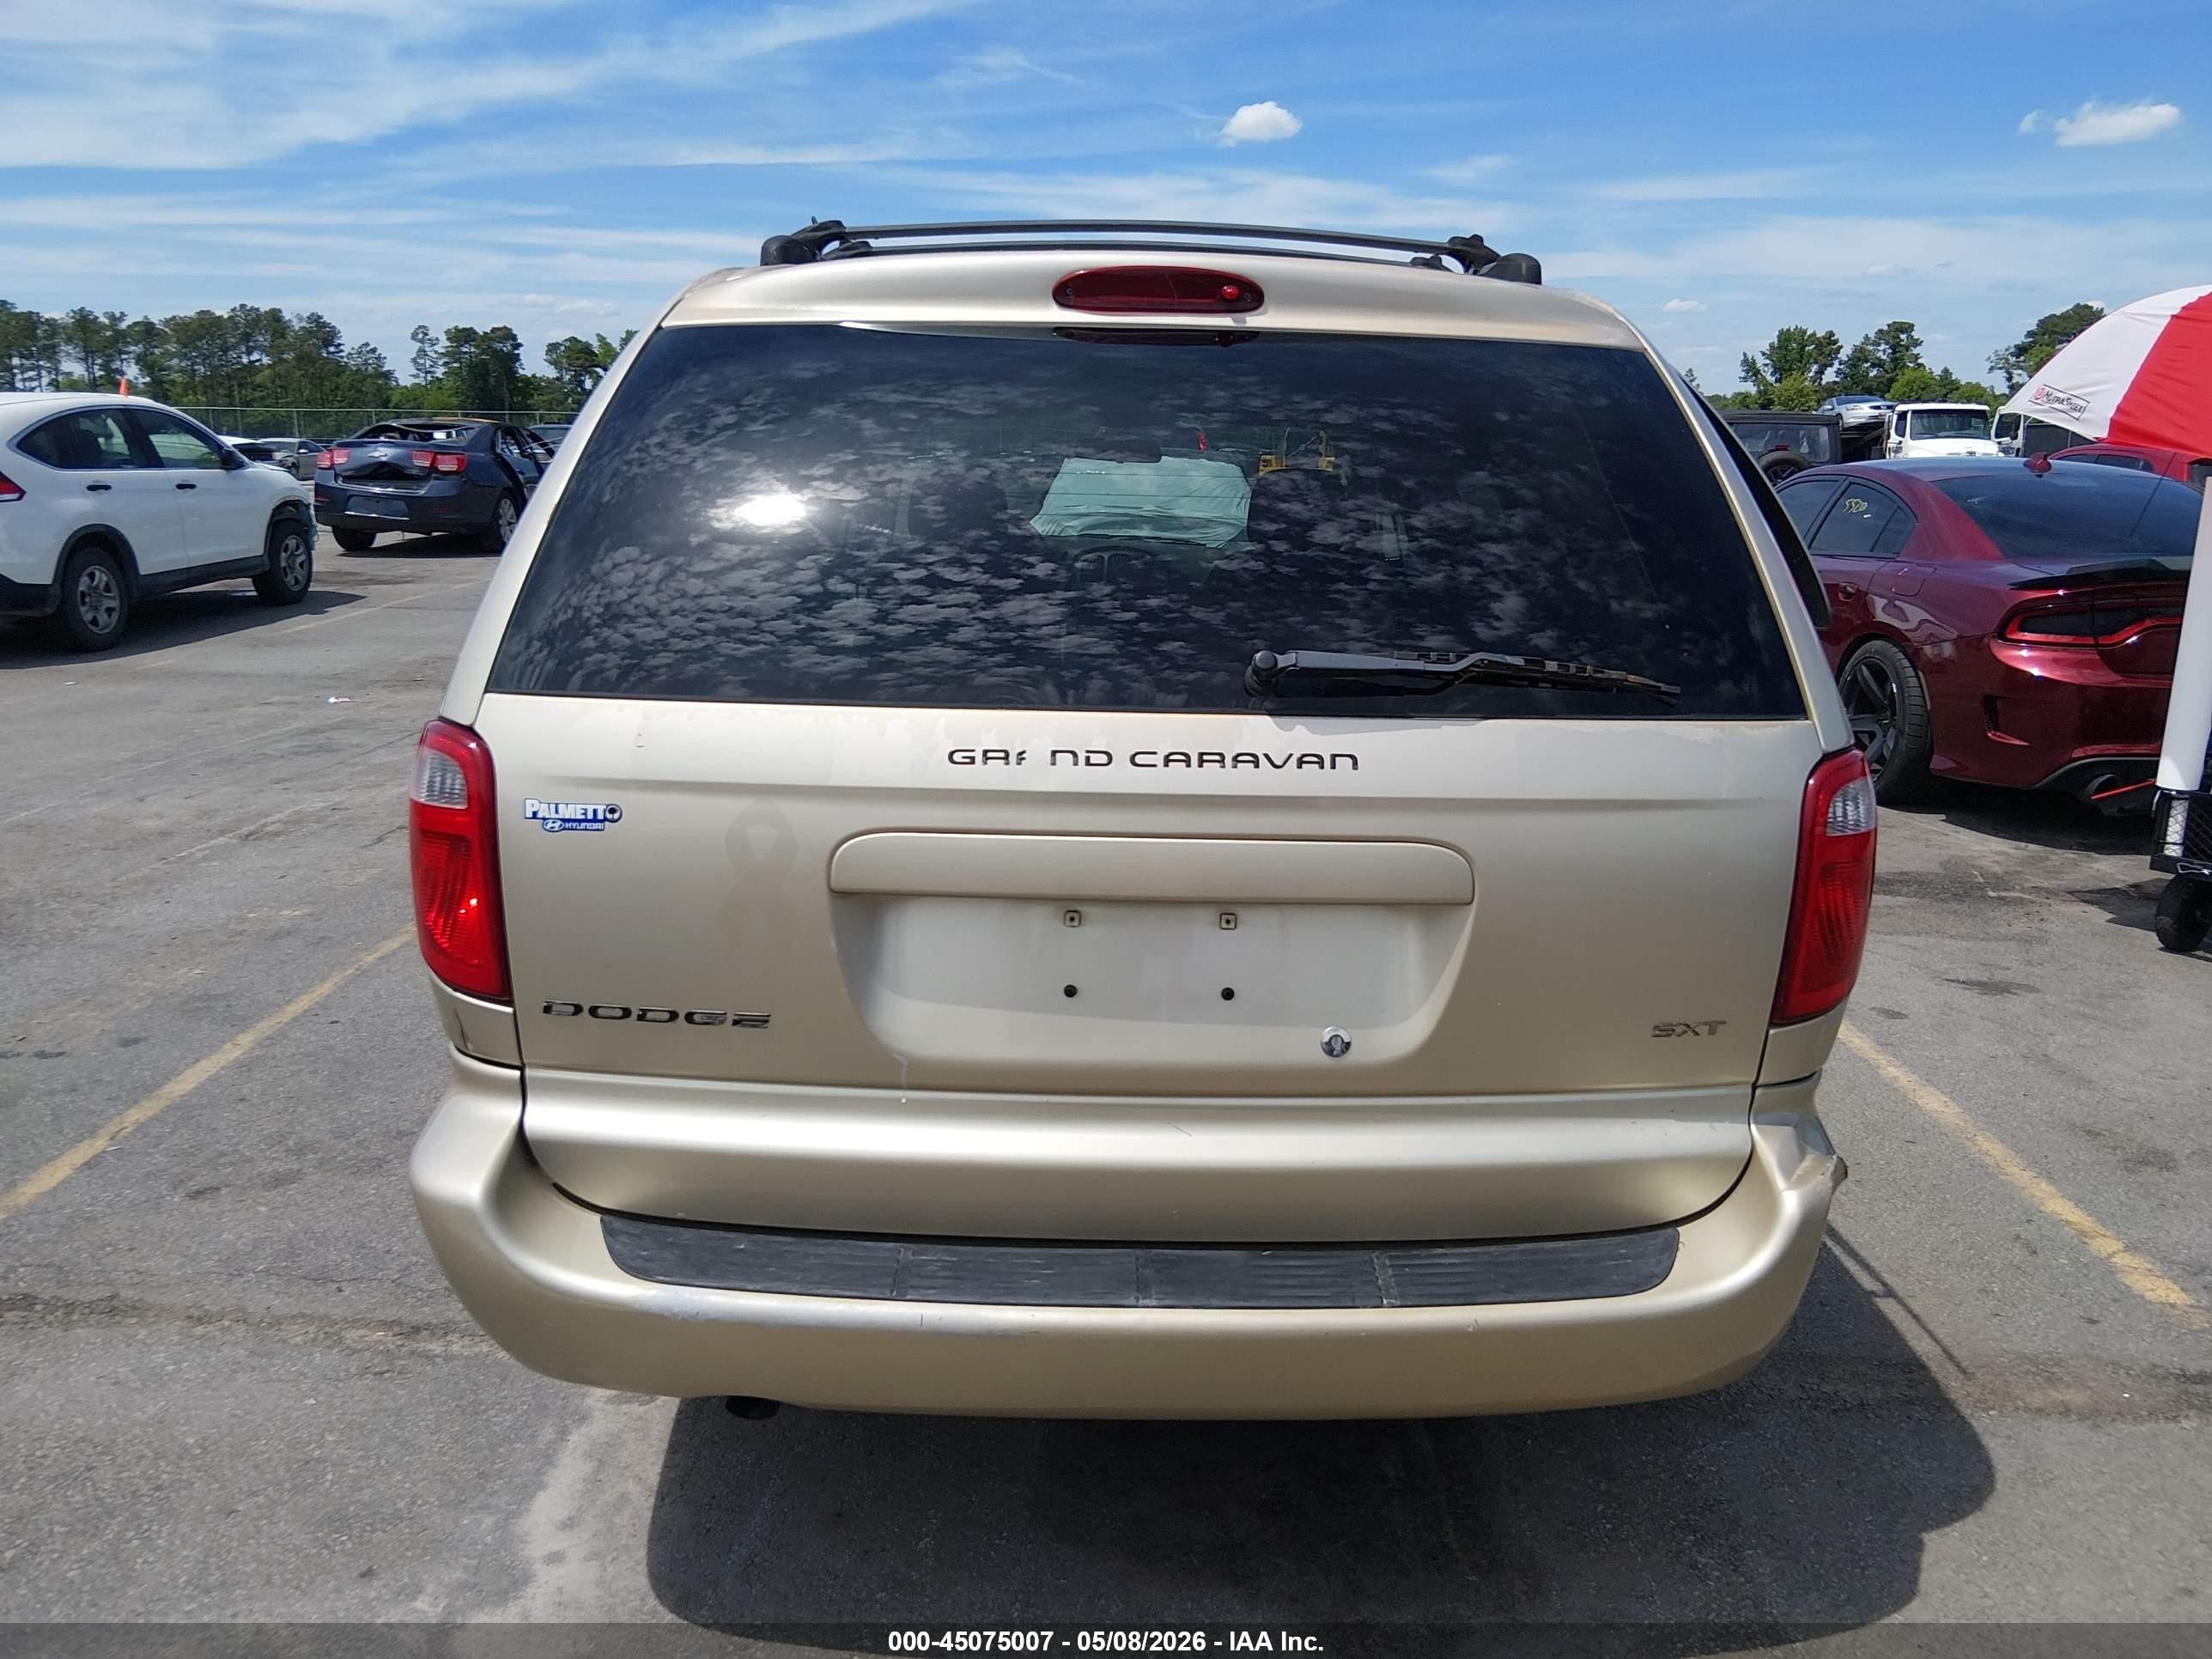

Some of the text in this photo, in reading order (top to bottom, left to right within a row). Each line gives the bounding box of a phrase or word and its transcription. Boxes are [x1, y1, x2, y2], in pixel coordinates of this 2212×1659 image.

[1129, 750, 1358, 770] CARAVAN
[524, 799, 622, 823] PALMETTO
[565, 822, 605, 830] HYUNDAI
[542, 1000, 772, 1029] DODGE
[1651, 1020, 1727, 1037] SXT
